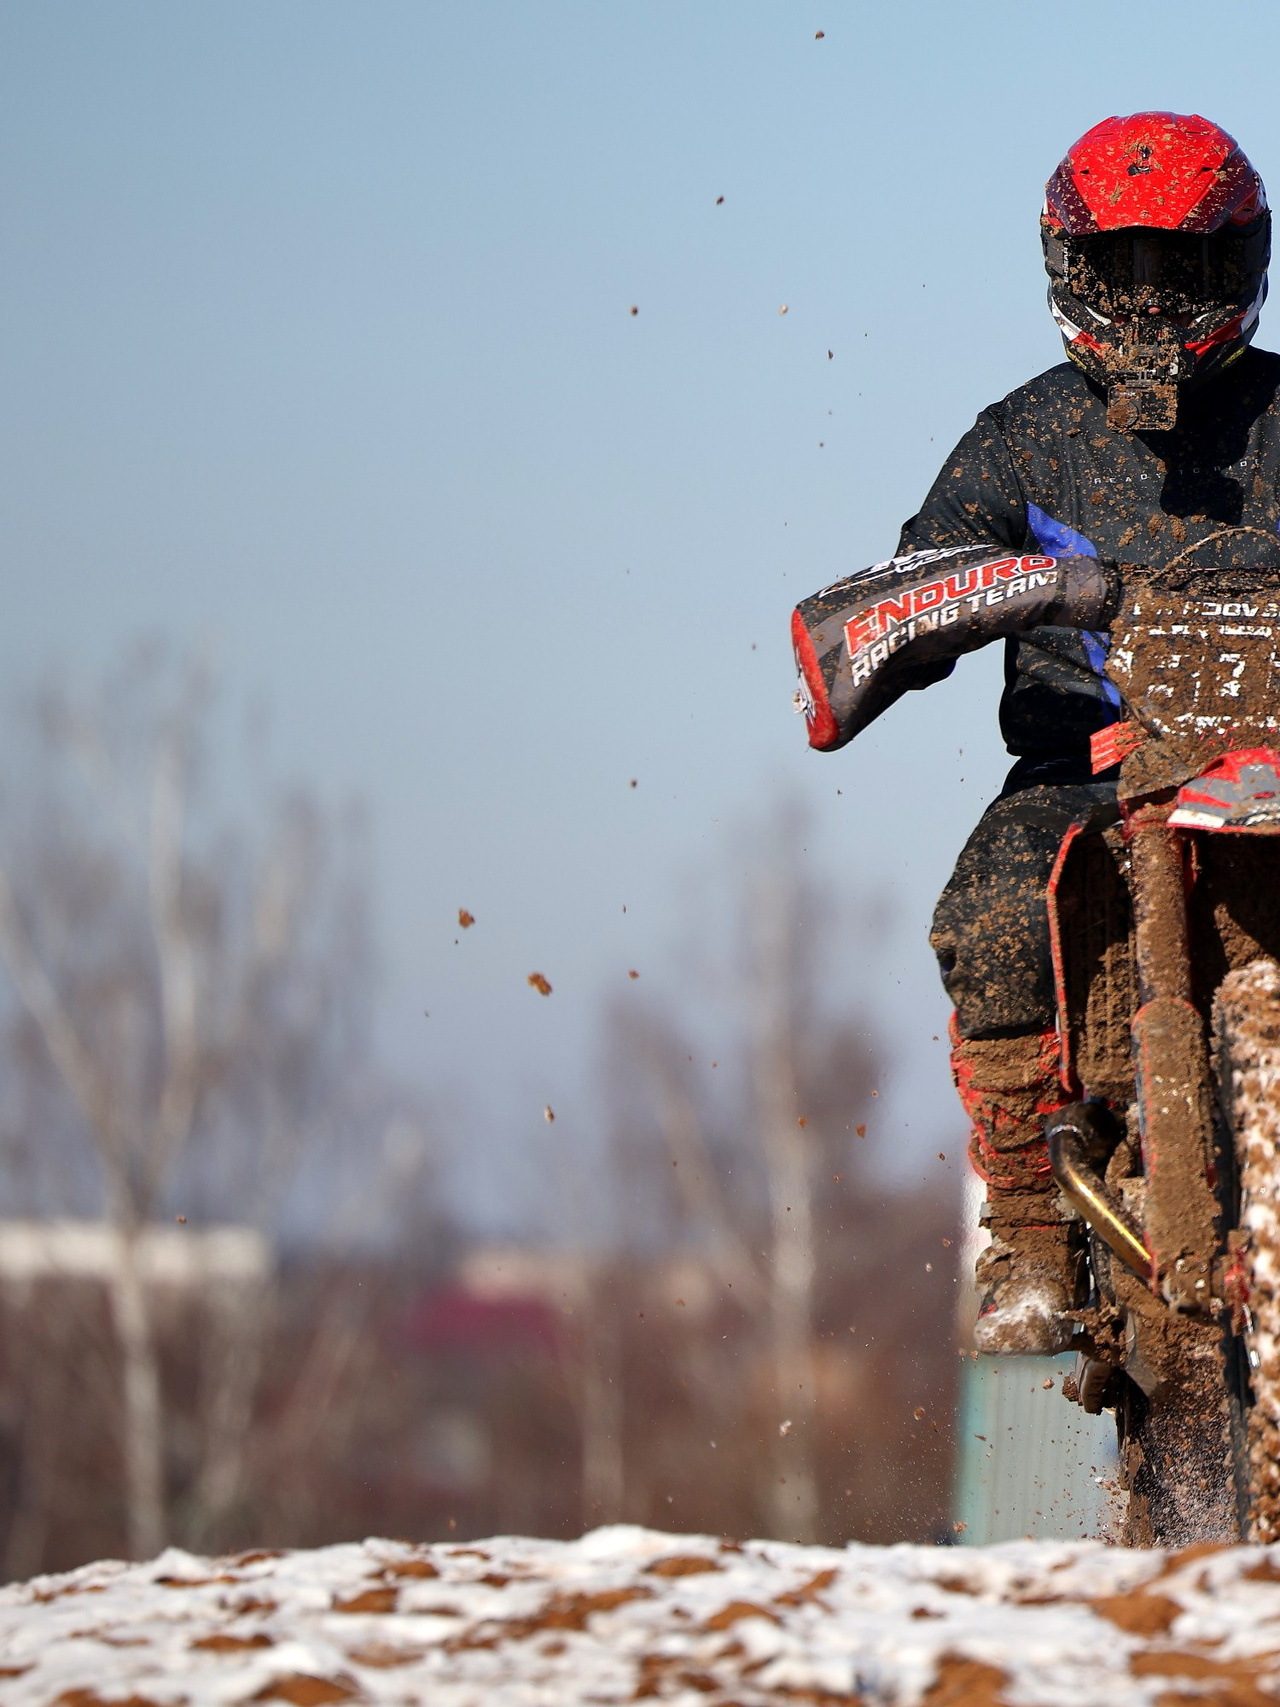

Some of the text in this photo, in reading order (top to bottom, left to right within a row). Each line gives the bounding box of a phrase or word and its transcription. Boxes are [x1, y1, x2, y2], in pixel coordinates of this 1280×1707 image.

[844, 555, 1057, 660] ENDURO
[851, 602, 960, 688] RACING
[965, 571, 1059, 613] TEAM
